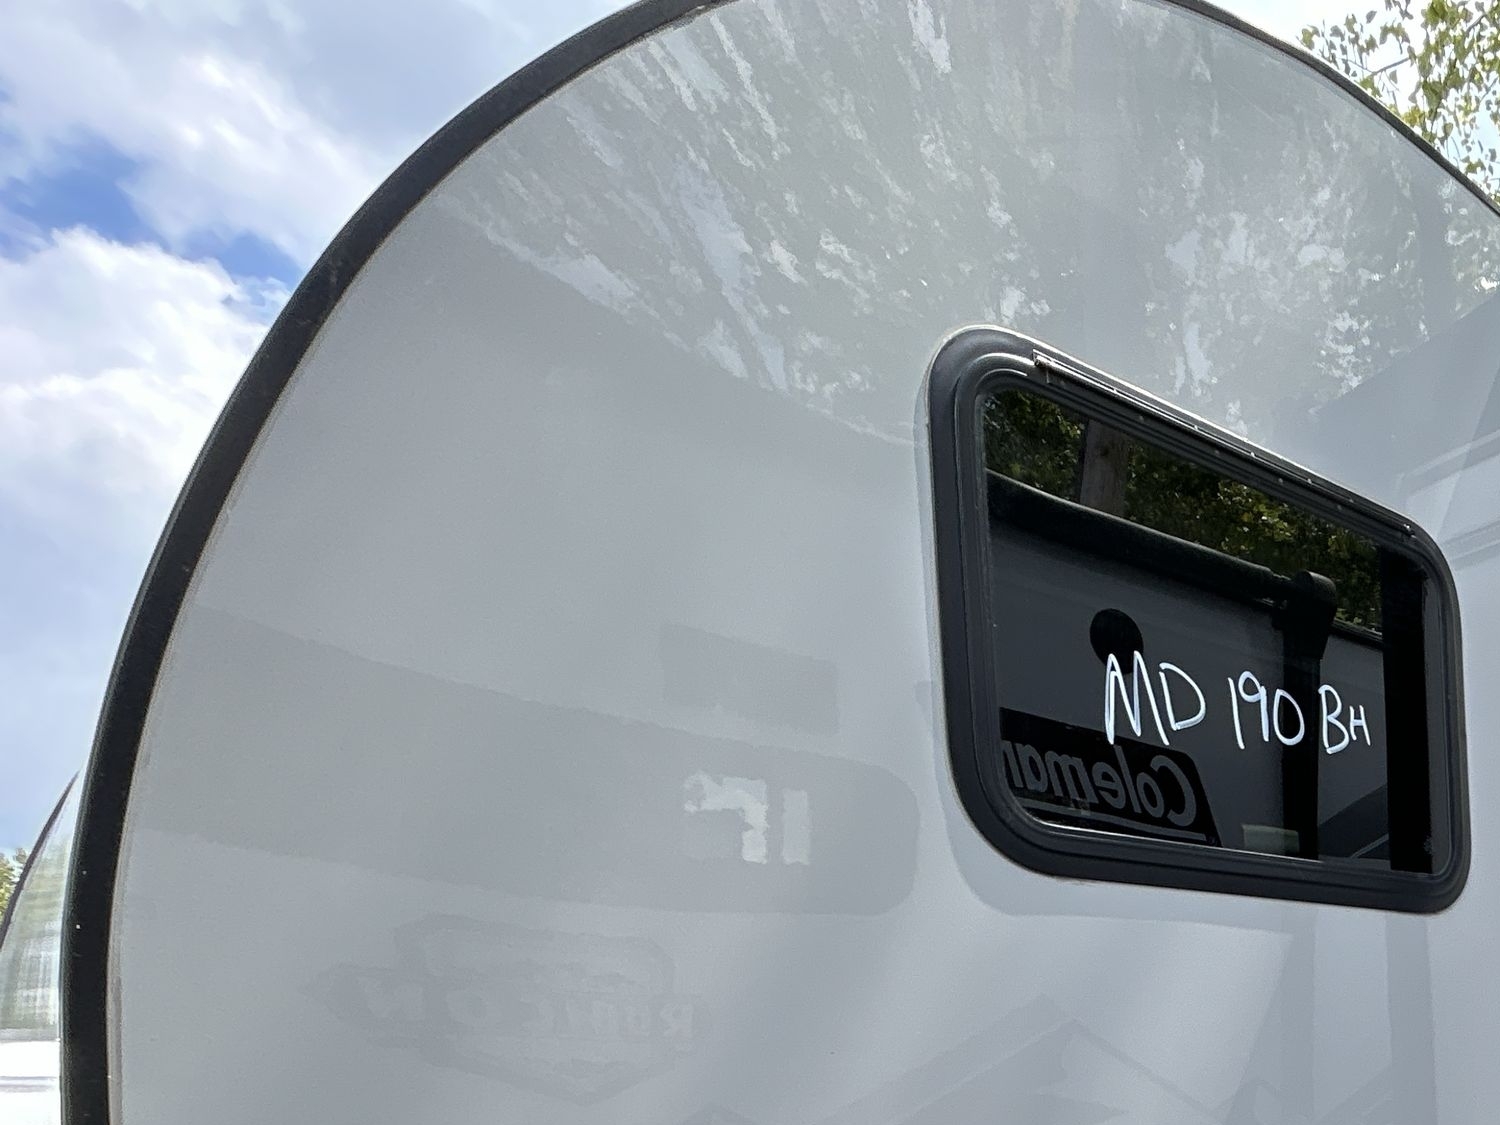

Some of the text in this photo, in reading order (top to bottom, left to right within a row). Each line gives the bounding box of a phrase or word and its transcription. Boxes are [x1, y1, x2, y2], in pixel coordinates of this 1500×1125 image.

[1104, 650, 1372, 754] MD 190 BH
